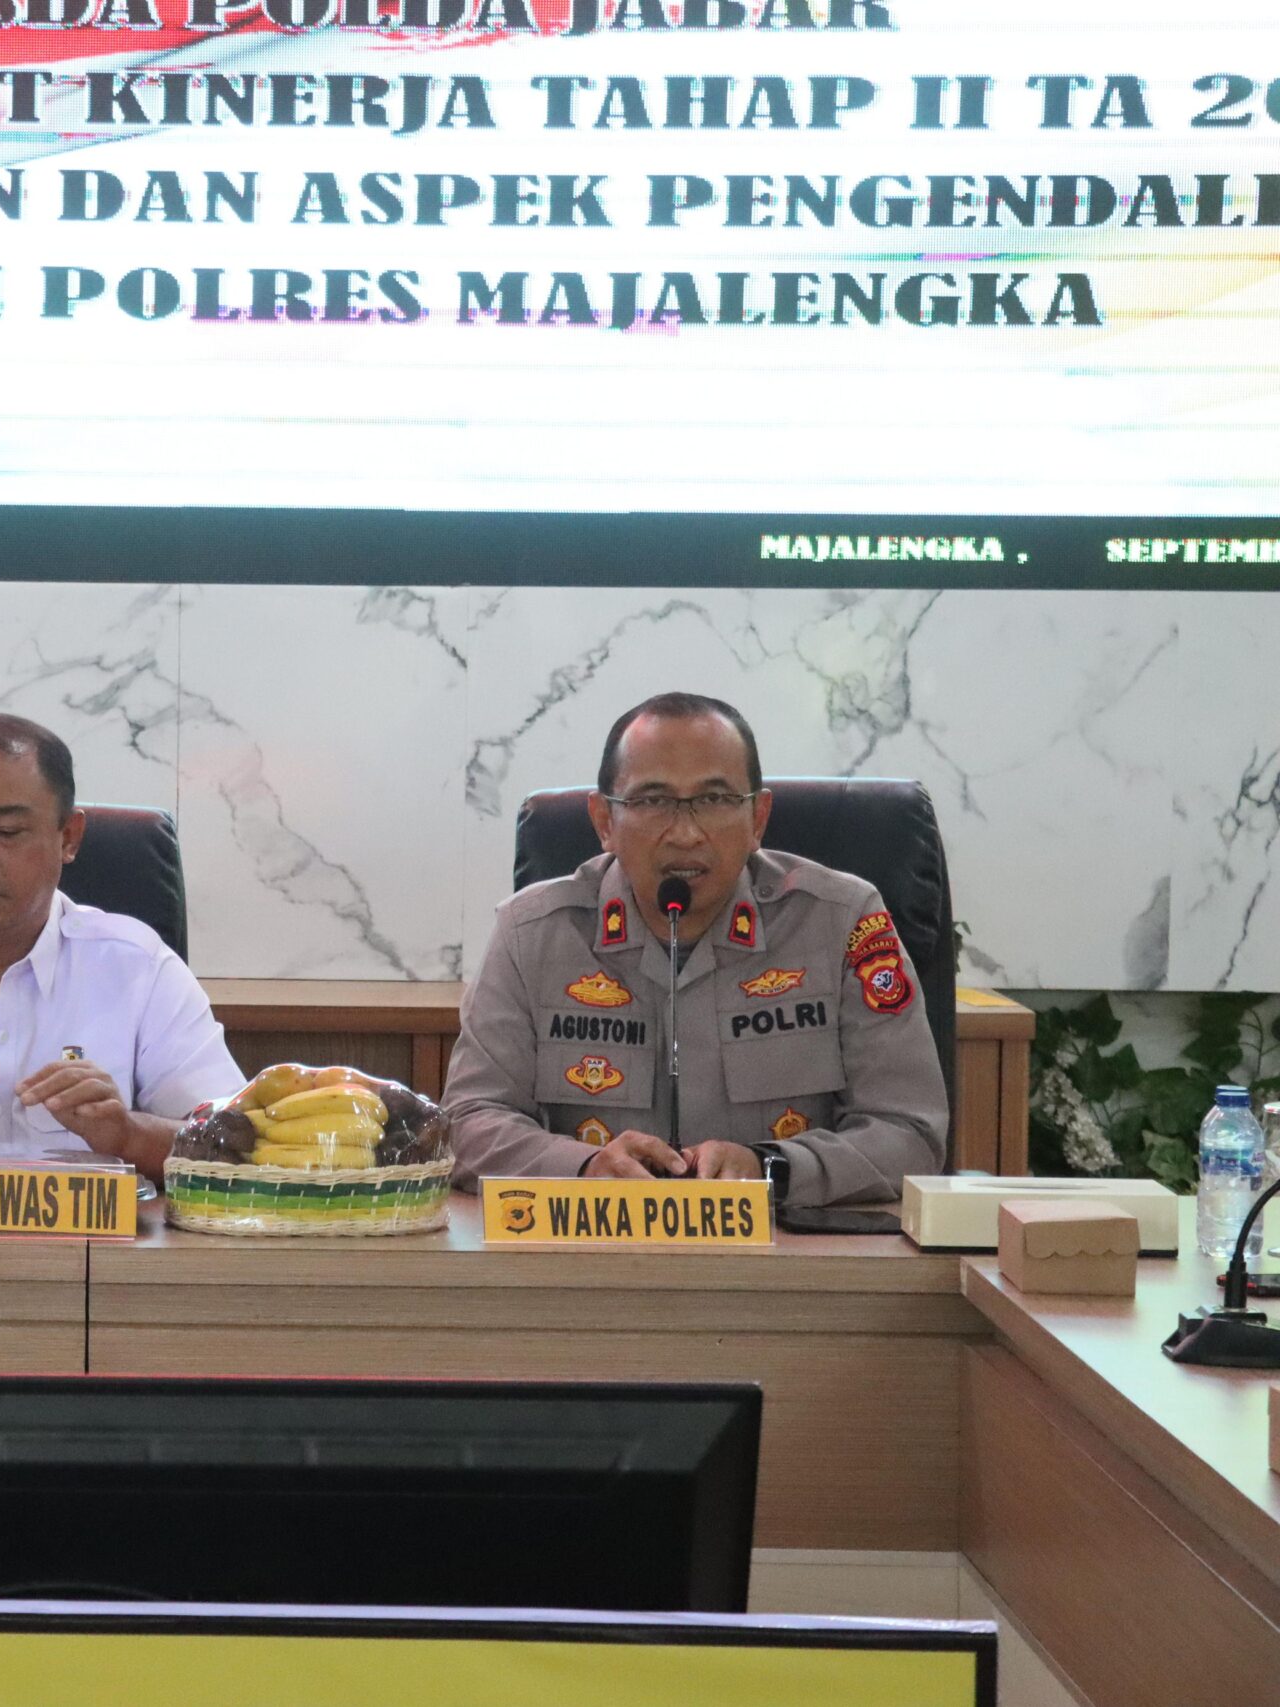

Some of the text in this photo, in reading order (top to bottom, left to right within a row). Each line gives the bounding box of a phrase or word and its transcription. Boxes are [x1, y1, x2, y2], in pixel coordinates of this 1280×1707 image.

[86, 72, 496, 136] KINERJA
[531, 74, 880, 128] TAHAP
[909, 75, 993, 129] II
[1025, 74, 1153, 128] TA
[57, 169, 259, 225] DAN
[292, 172, 613, 228] ASPEK
[40, 266, 424, 324] POLRES
[457, 271, 1106, 330] MAJALENGKA
[760, 534, 1005, 563] MAJALENGKA
[549, 1013, 647, 1046] AGUSTONI
[731, 1001, 827, 1038] POLRI
[69, 1175, 118, 1231] TIM
[548, 1196, 754, 1238] WAKA POLRES
